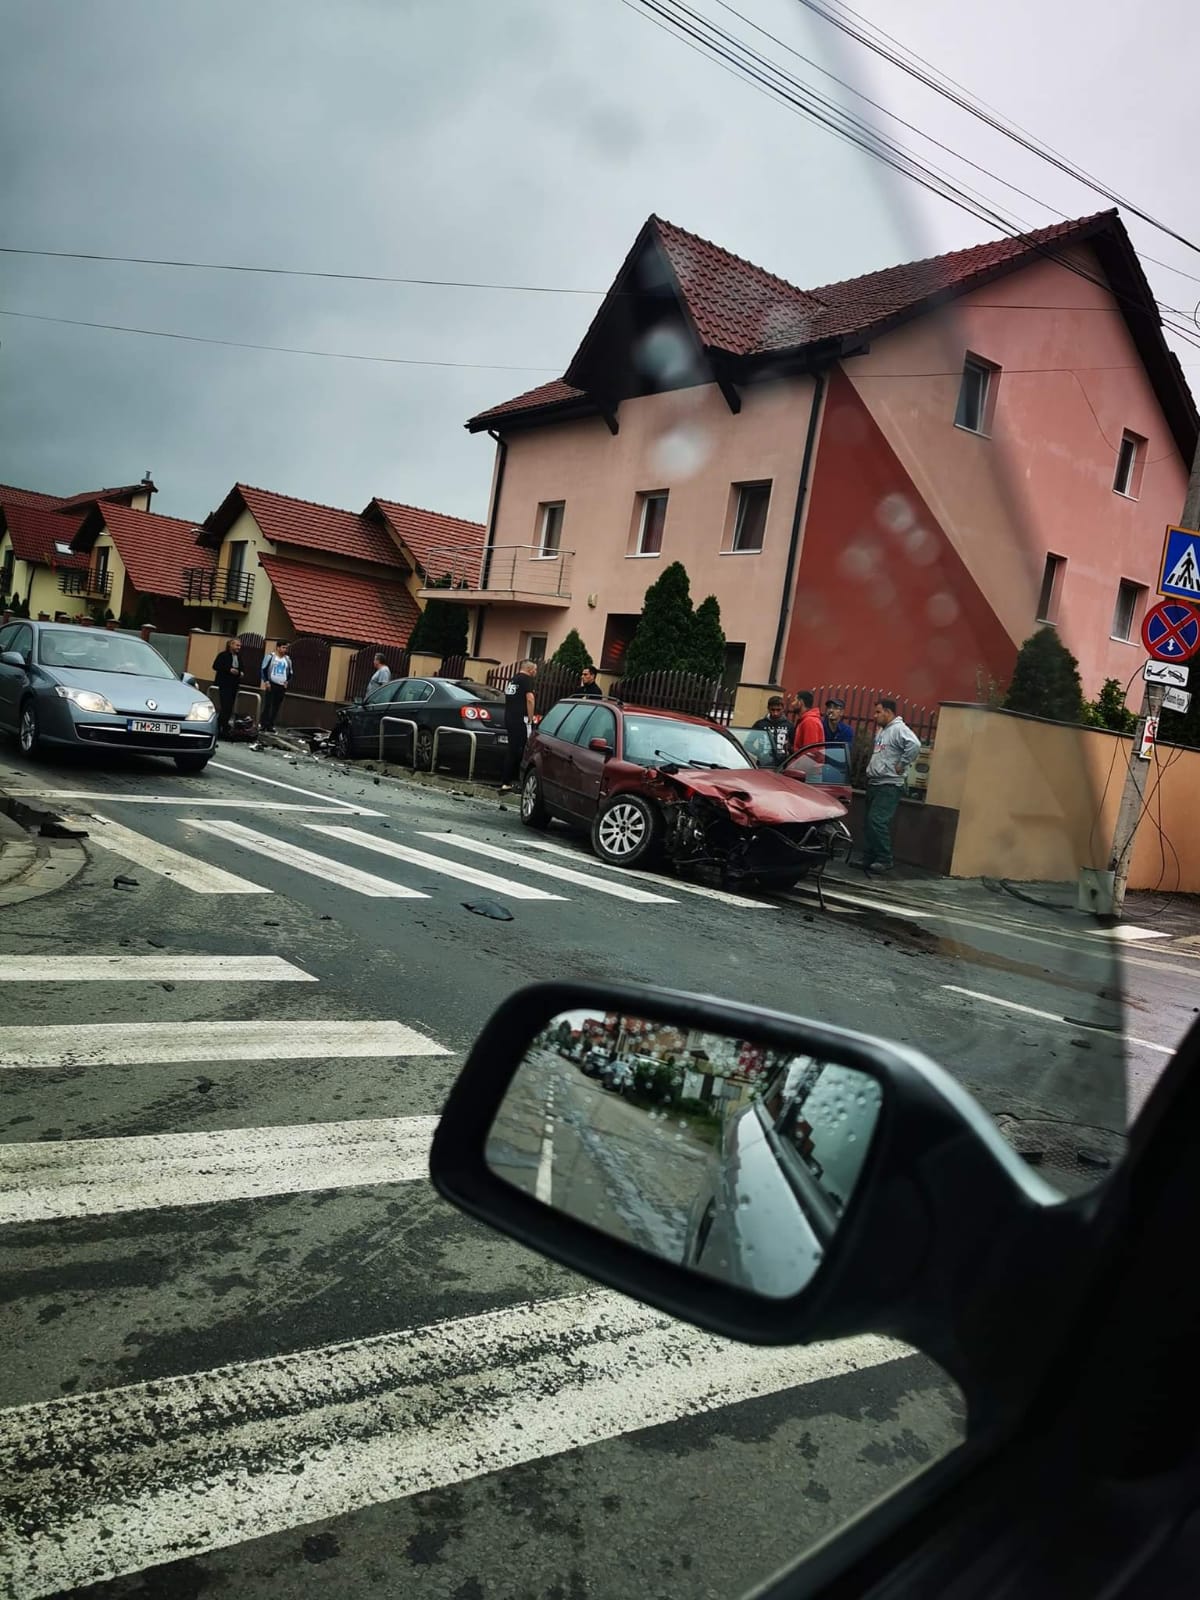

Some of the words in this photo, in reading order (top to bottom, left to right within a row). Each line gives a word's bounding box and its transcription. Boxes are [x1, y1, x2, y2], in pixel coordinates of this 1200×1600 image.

[135, 721, 147, 731] TM
[150, 722, 161, 731] 28
[165, 723, 178, 732] TIP
